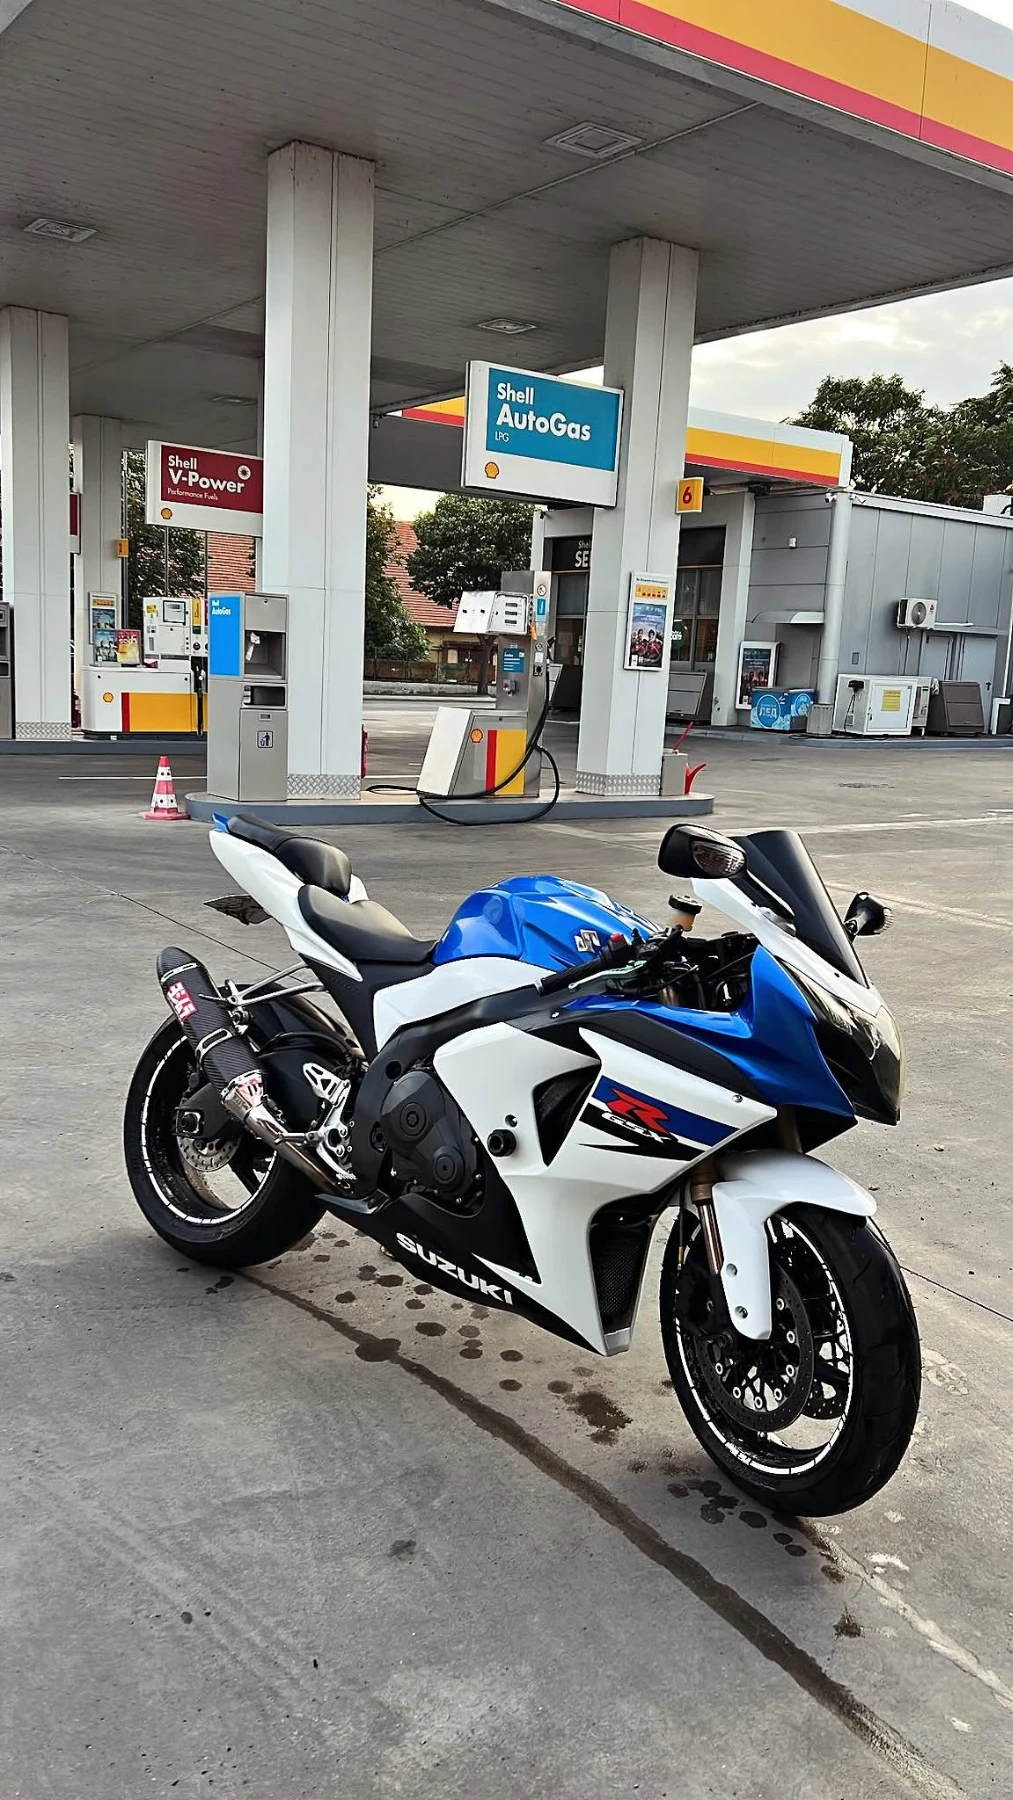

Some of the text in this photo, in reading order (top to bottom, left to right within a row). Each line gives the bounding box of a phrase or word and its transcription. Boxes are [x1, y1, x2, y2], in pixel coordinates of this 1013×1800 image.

[497, 382, 534, 405] Shell
[496, 403, 591, 441] AutoGas
[495, 431, 509, 442] LPG
[168, 455, 197, 469] Shell
[168, 468, 245, 493] V-Power
[167, 487, 219, 501] Performance Fuels
[682, 486, 692, 504] 6
[574, 550, 590, 568] SE
[759, 706, 777, 719] ЛЕД
[396, 1232, 513, 1305] SUZUKI
